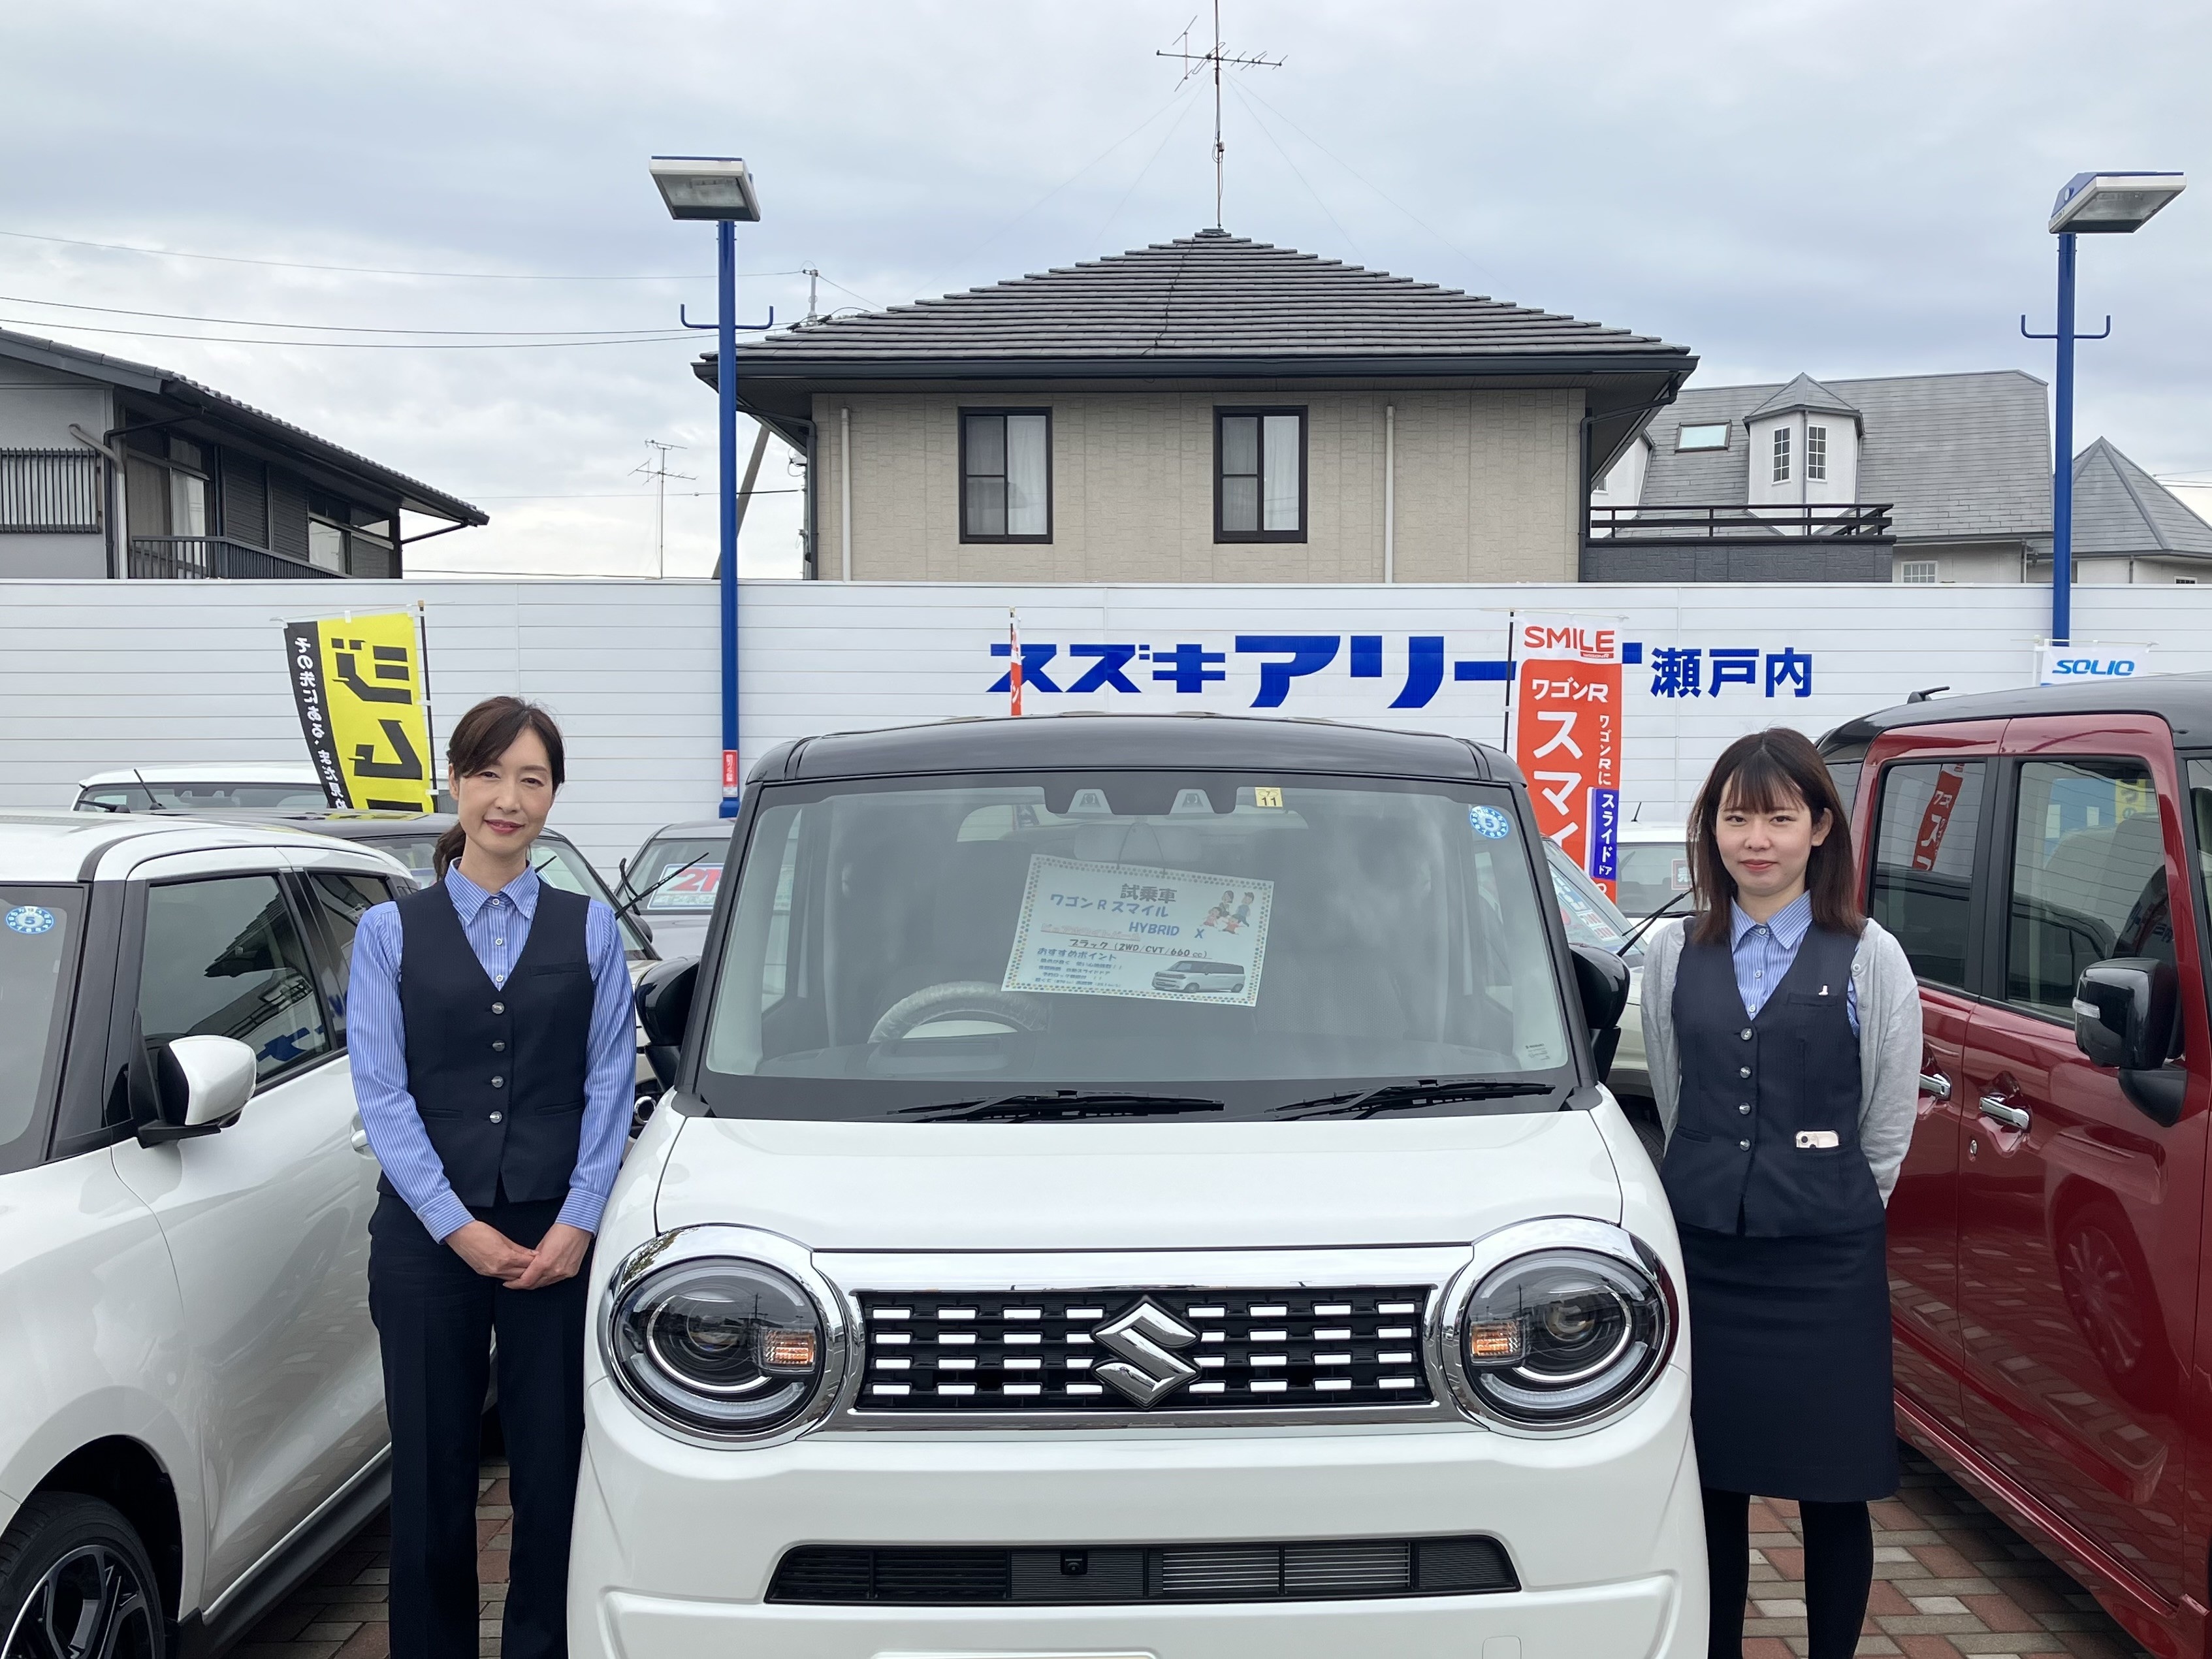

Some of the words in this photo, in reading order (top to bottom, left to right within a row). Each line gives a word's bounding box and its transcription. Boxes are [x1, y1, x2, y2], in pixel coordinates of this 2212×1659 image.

[1524, 626, 1615, 652] SMILE
[986, 635, 1643, 709] スズキアリー
[1650, 647, 1813, 699] 瀬戸内
[2051, 659, 2136, 677] SOLIO
[1531, 676, 1609, 703] ワゴンR
[1598, 715, 1612, 786] ワゴンRに
[1261, 796, 1277, 807] 11
[1484, 818, 1494, 828] 5
[1120, 882, 1178, 904] 試乗車
[24, 916, 35, 925] 5
[1129, 921, 1180, 936] HYBRID
[1194, 927, 1205, 939] X
